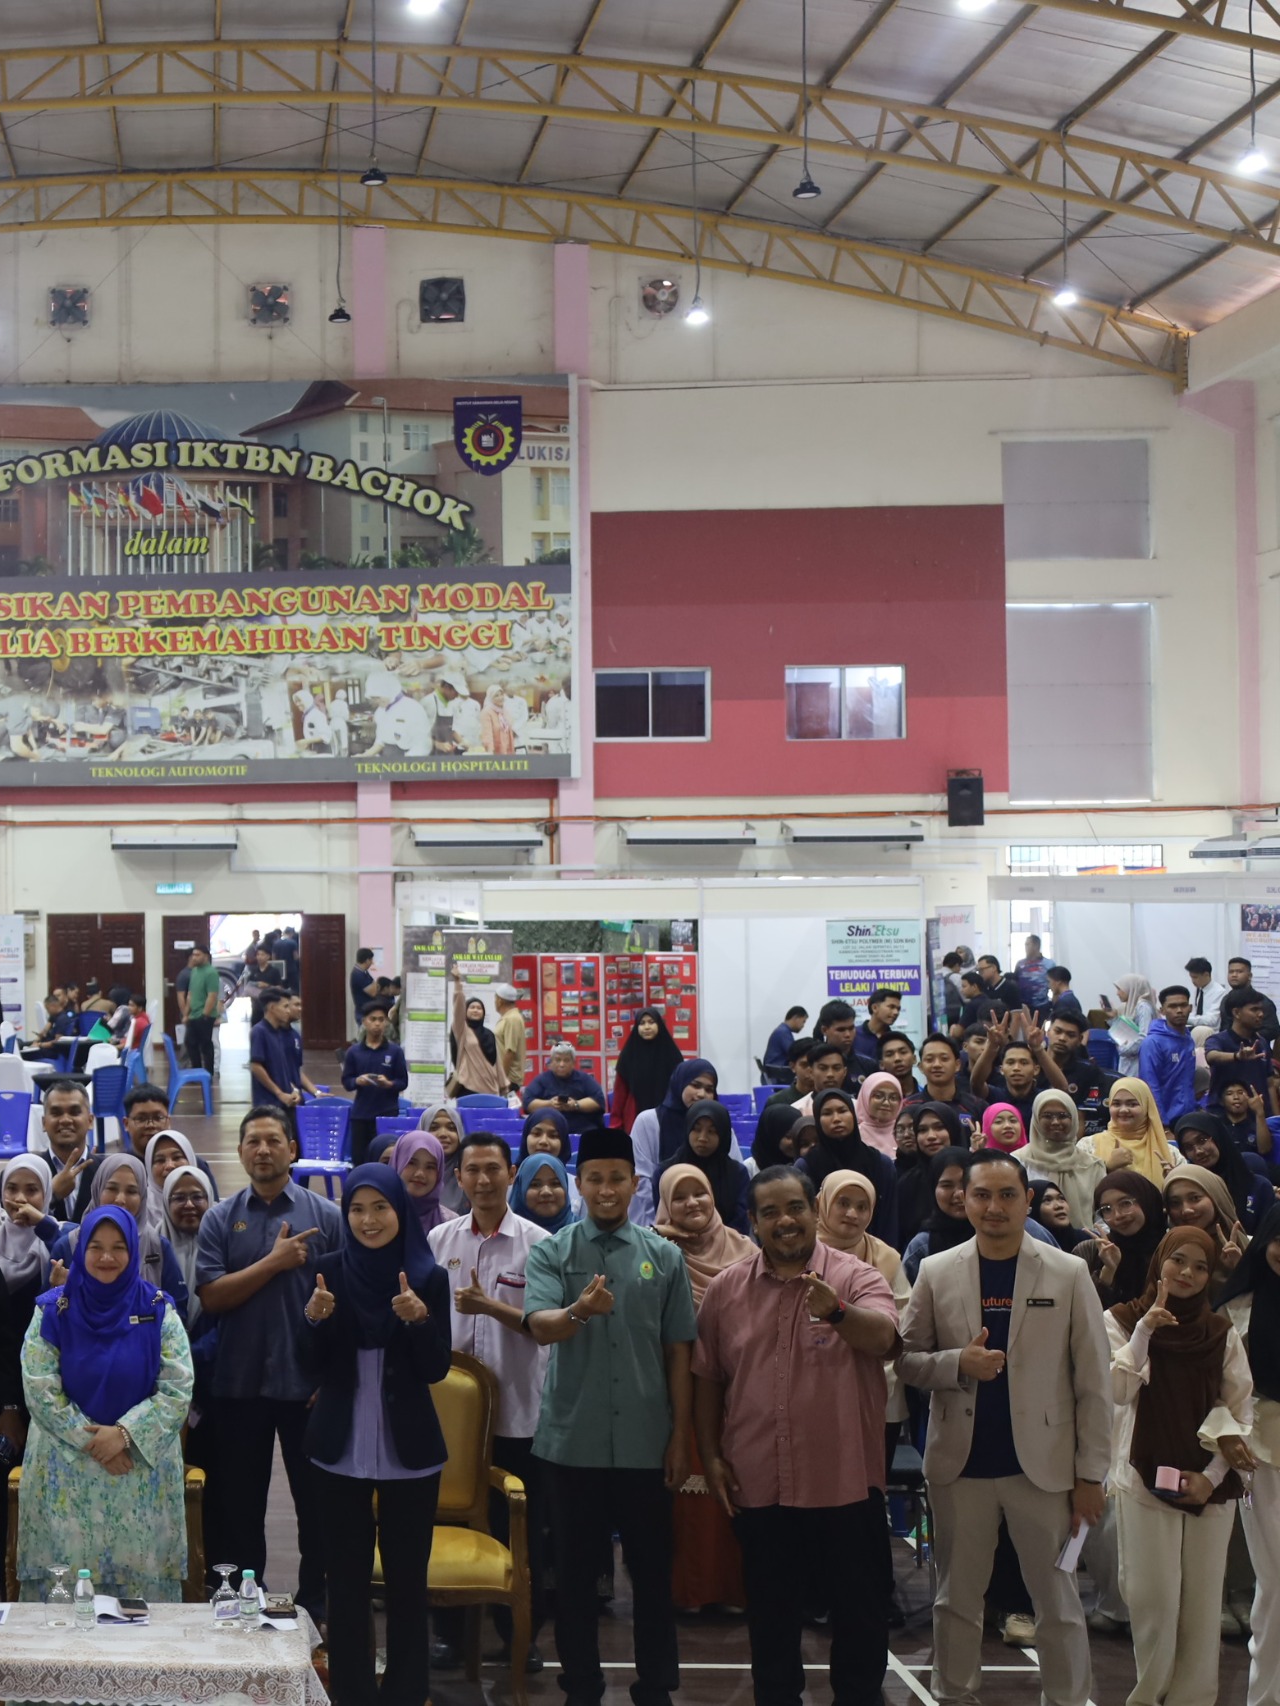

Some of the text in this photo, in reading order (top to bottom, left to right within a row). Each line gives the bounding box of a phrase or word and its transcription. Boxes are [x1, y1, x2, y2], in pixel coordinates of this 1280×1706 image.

[176, 441, 300, 477] IKTBN
[305, 452, 471, 531] BACHOK
[124, 530, 209, 556] dalam
[117, 586, 410, 620] PEMBANGUNAN
[418, 582, 553, 612] MODAL
[68, 623, 367, 656] BERKEMAHIRAN
[377, 620, 512, 650] TINGGI
[90, 765, 248, 778] TEKNOLOGI AUTOMOTIF
[355, 760, 529, 774] TEKNOLOGI HOSPITALITI
[829, 969, 919, 980] TEMUDUGA TERBUKA
[840, 982, 871, 992] LELAKI
